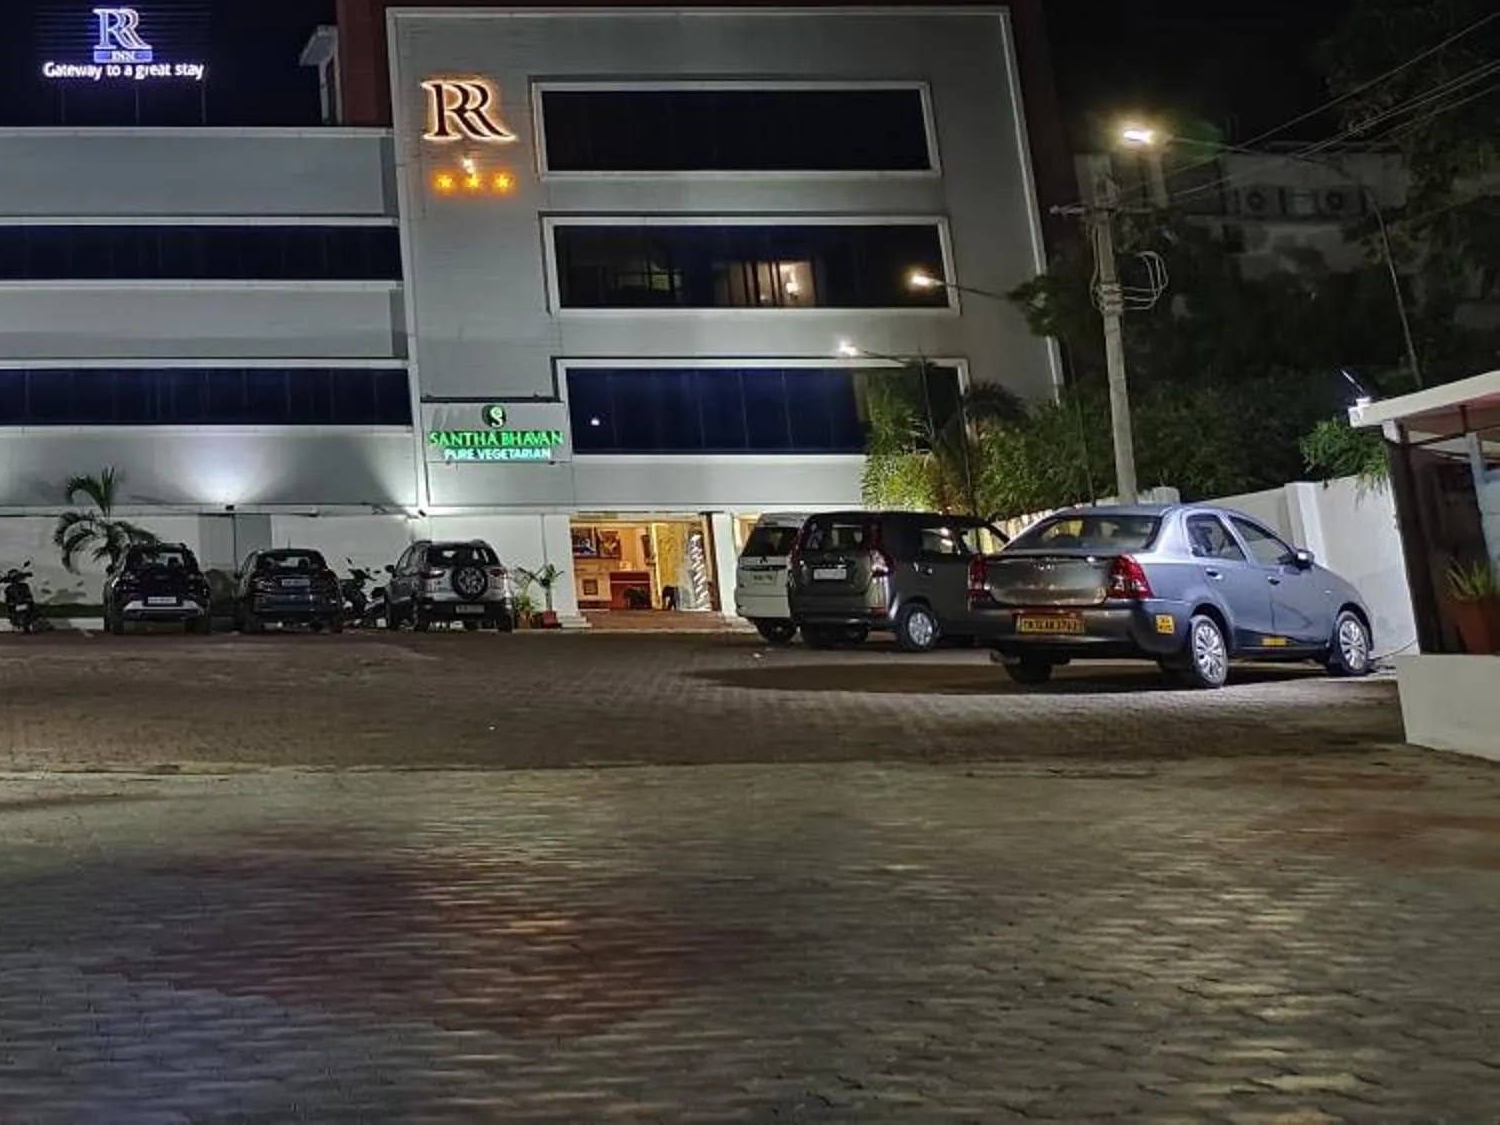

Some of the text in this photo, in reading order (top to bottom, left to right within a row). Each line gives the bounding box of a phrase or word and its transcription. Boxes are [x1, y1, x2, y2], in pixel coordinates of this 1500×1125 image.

[111, 50, 136, 62] INN
[42, 61, 204, 80] Gateway to a great stay
[429, 431, 564, 446] SANTHA BHAVAN
[443, 447, 551, 460] PURE VEGETARIAN
